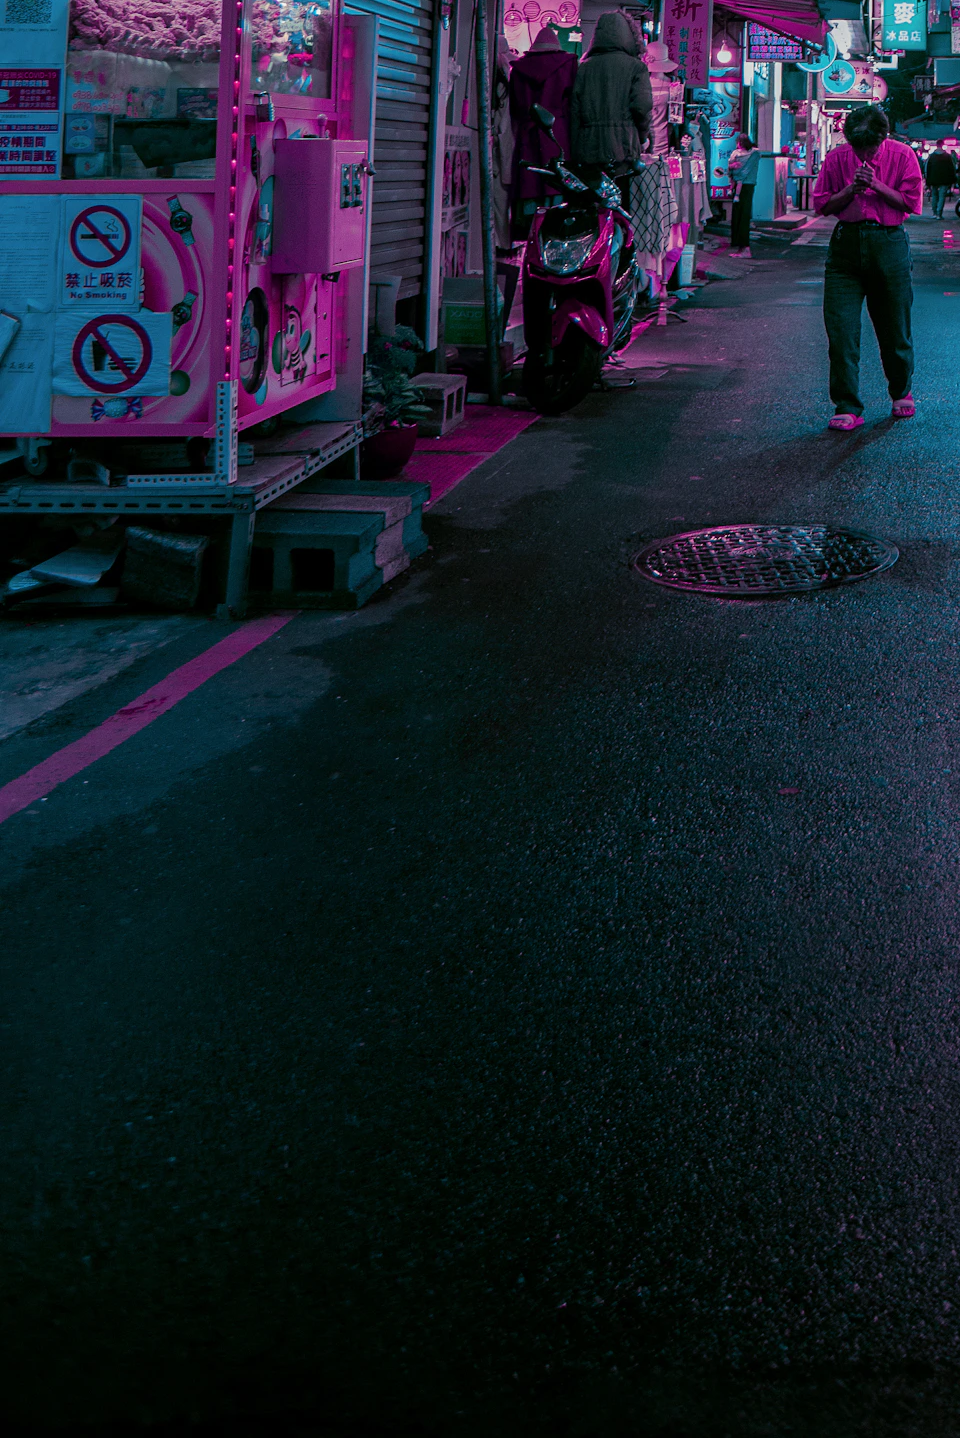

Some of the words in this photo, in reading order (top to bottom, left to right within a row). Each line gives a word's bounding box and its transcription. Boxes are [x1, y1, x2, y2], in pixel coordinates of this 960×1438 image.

[885, 30, 922, 42] 冰品店
[66, 272, 133, 288] 禁止吸菸
[70, 291, 83, 299] No
[85, 291, 127, 300] Smoking
